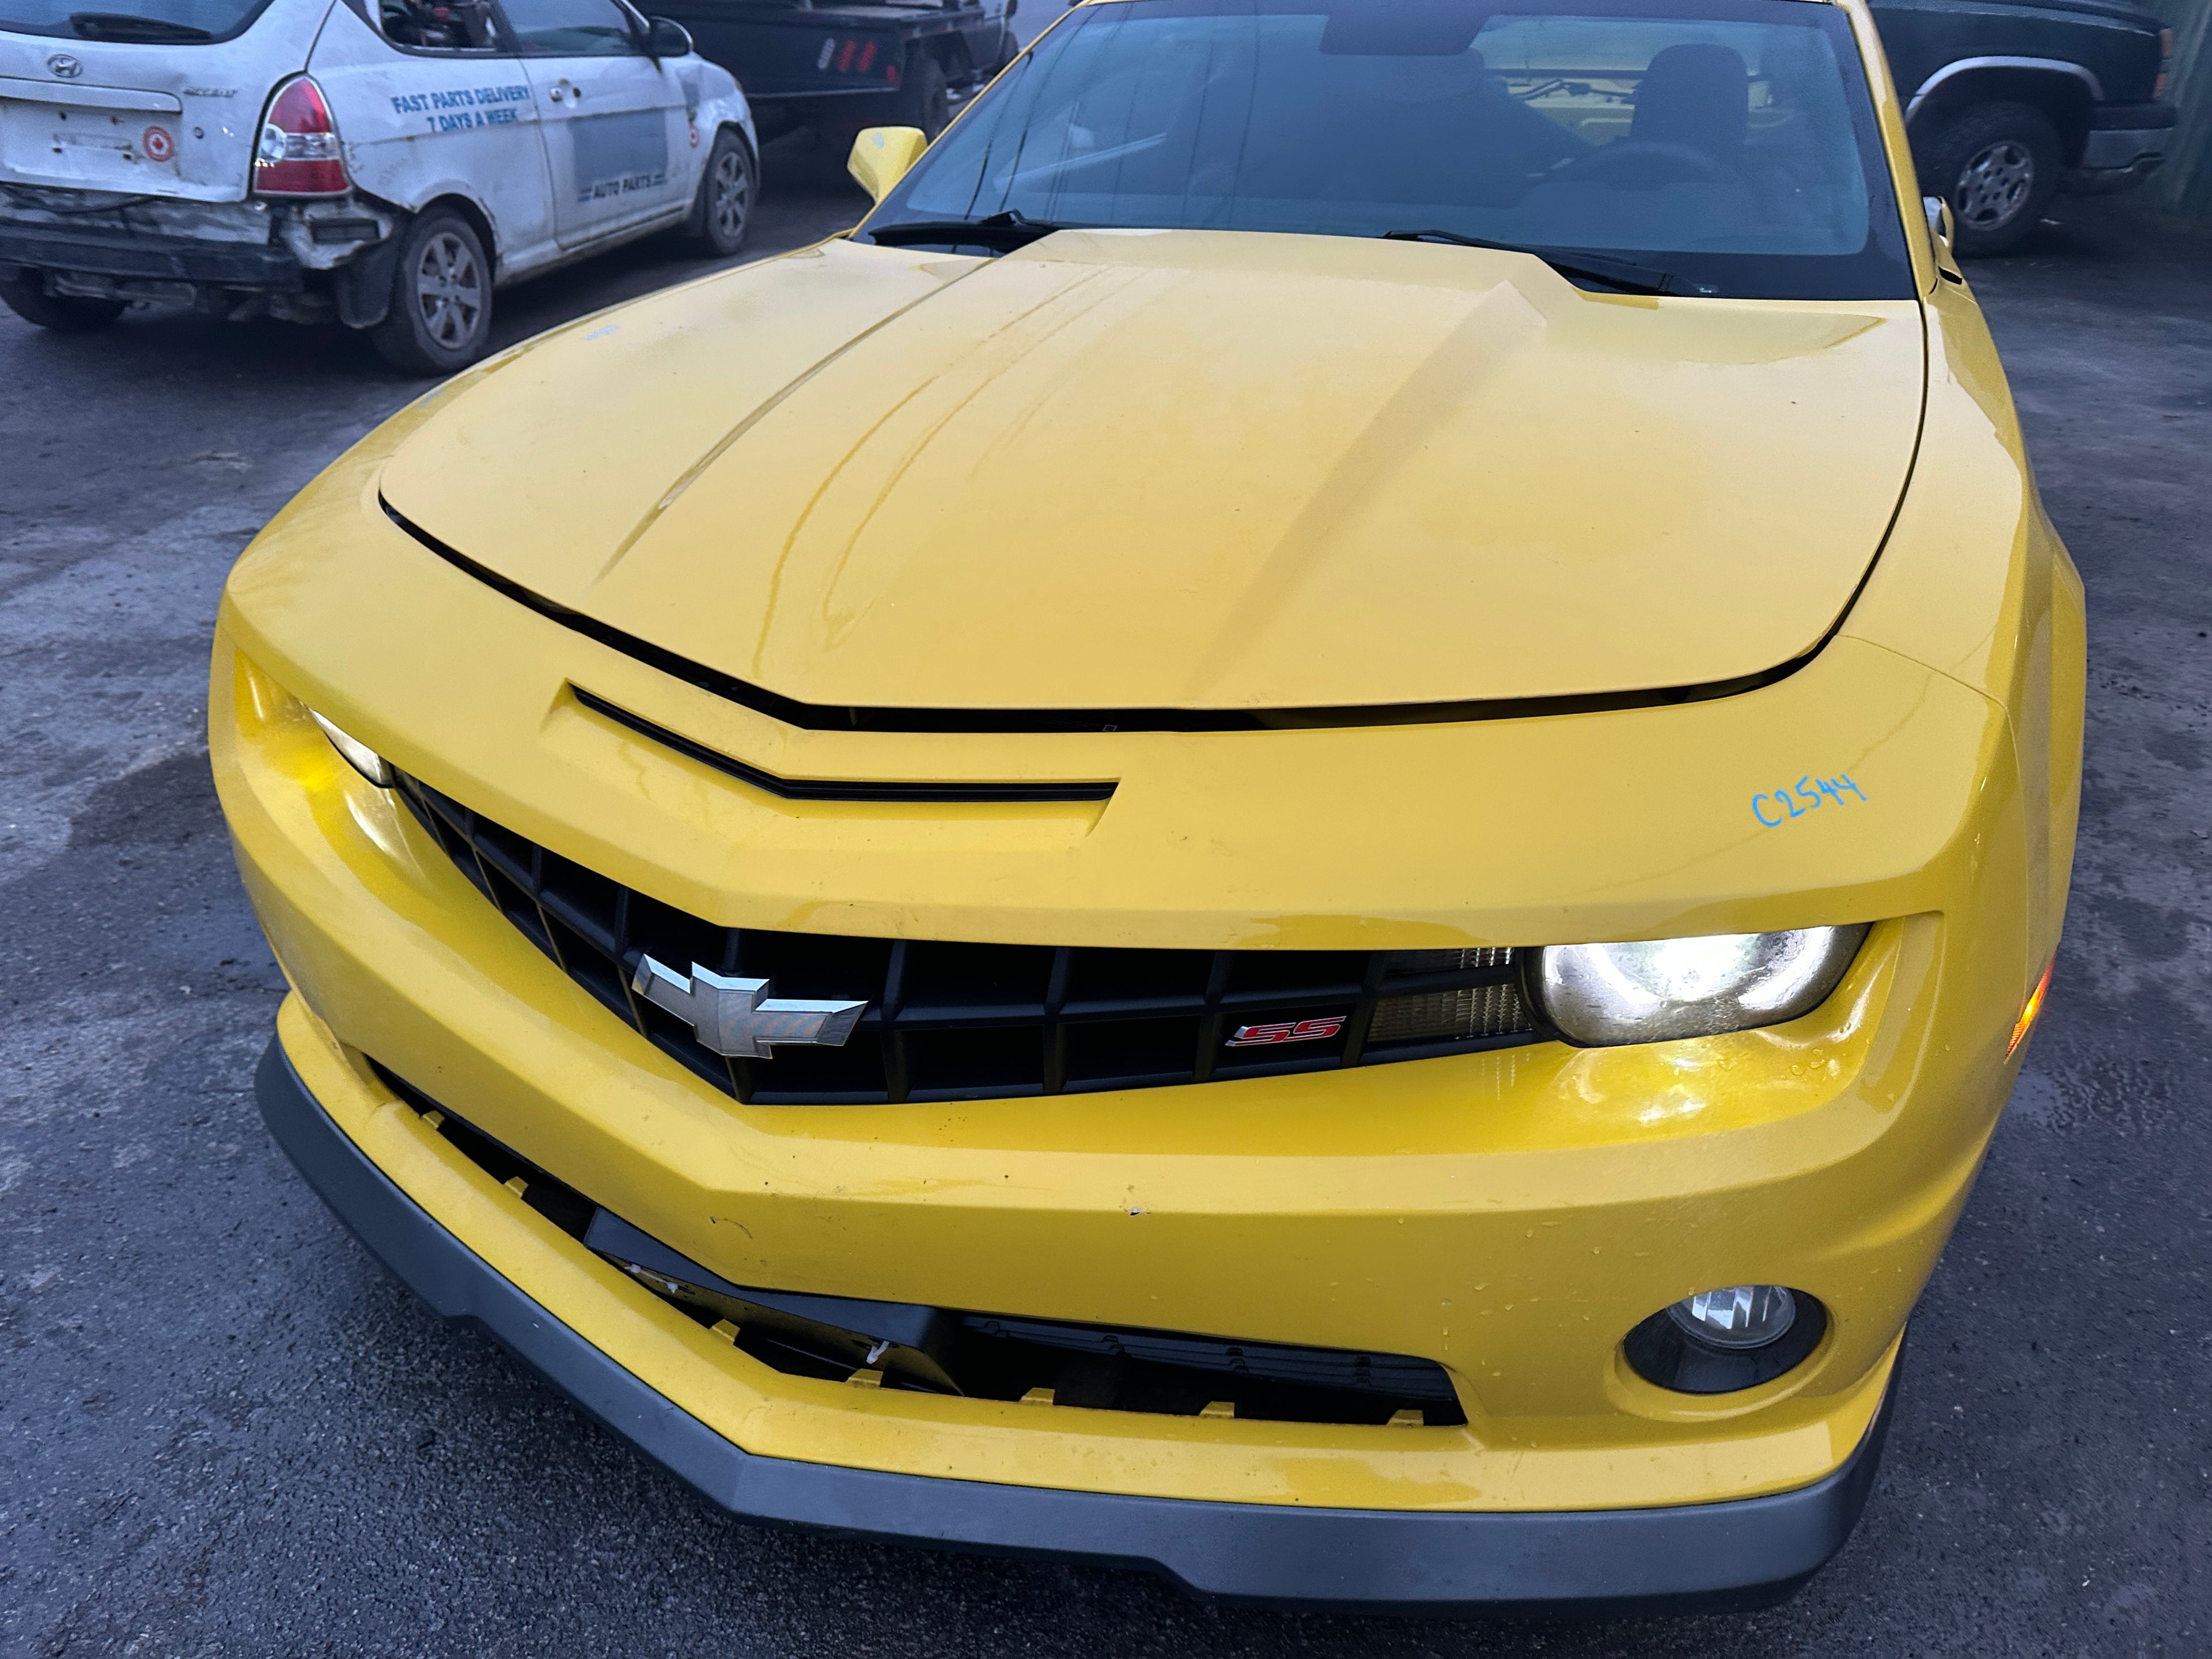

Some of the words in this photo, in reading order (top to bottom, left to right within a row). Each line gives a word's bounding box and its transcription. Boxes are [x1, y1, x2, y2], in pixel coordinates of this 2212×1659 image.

[391, 94, 429, 113] FAST
[430, 89, 474, 109] PARTS
[474, 86, 529, 104] DELIVERY
[426, 116, 435, 133] 7
[438, 112, 474, 132] DAYS
[475, 111, 484, 127] A
[485, 108, 517, 124] WEEK
[593, 181, 620, 199] AUTO
[622, 175, 652, 193] PARTS
[1752, 773, 1867, 827] C2544
[1225, 1016, 1347, 1047] SS
